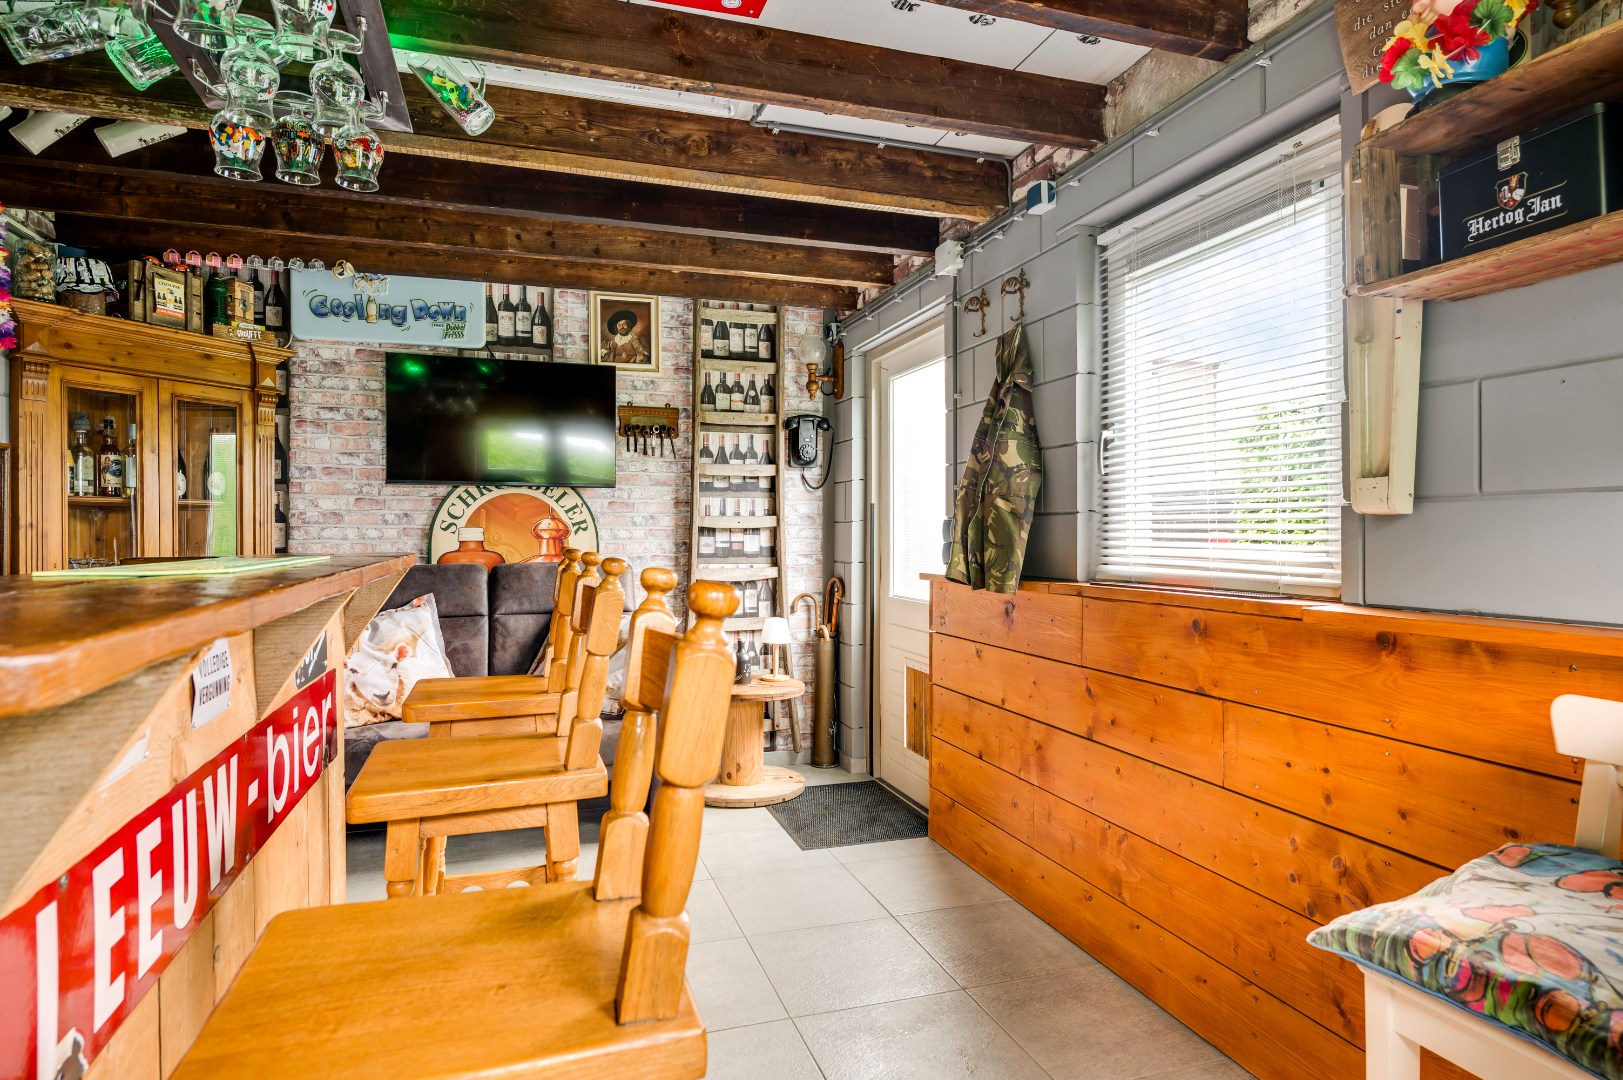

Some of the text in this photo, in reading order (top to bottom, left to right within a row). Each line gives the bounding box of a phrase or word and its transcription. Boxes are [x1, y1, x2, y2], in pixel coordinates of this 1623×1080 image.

[1354, 13, 1373, 31] die
[1370, 20, 1393, 40] dan
[1467, 194, 1563, 242] Hertog Jan
[198, 650, 229, 679] VOLLEDIGE
[199, 674, 231, 706] VERGUNNING
